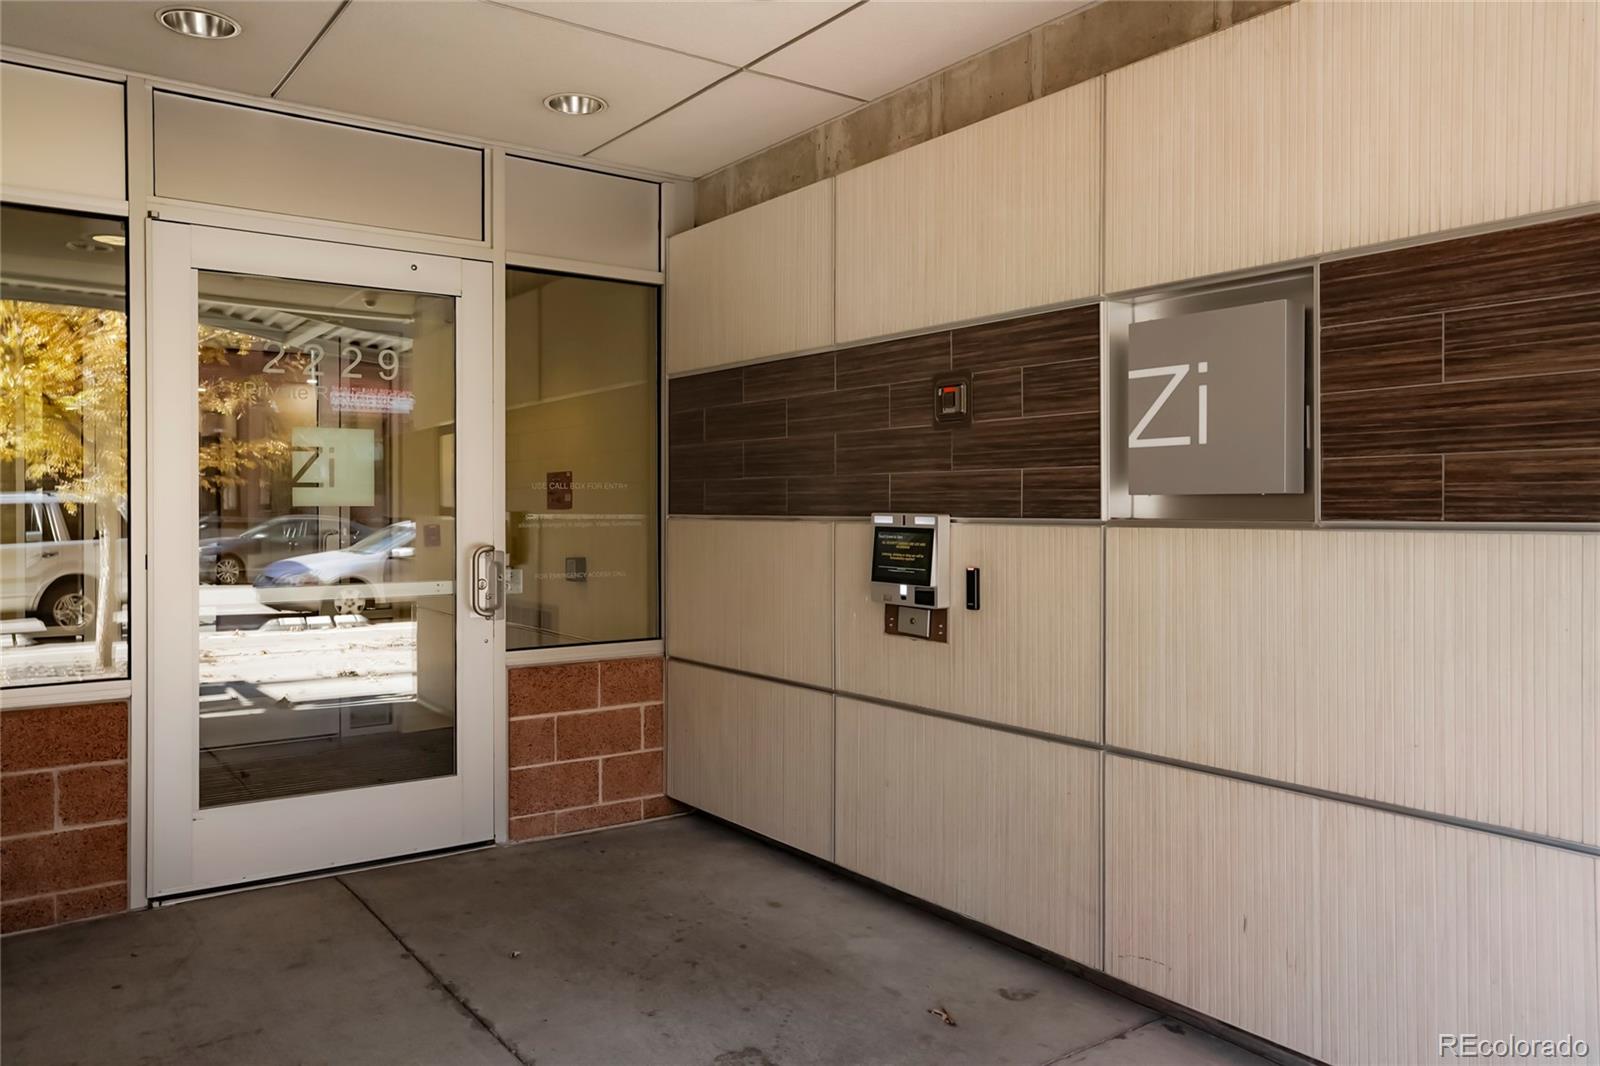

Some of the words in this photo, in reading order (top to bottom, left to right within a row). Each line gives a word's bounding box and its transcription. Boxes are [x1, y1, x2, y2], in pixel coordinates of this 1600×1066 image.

[262, 342, 399, 381] 2229
[243, 381, 309, 401] Privte
[1128, 361, 1208, 448] Zi
[291, 446, 335, 488] Zi
[548, 481, 568, 490] CALL
[570, 482, 585, 490] BOX
[587, 481, 602, 490] FOR
